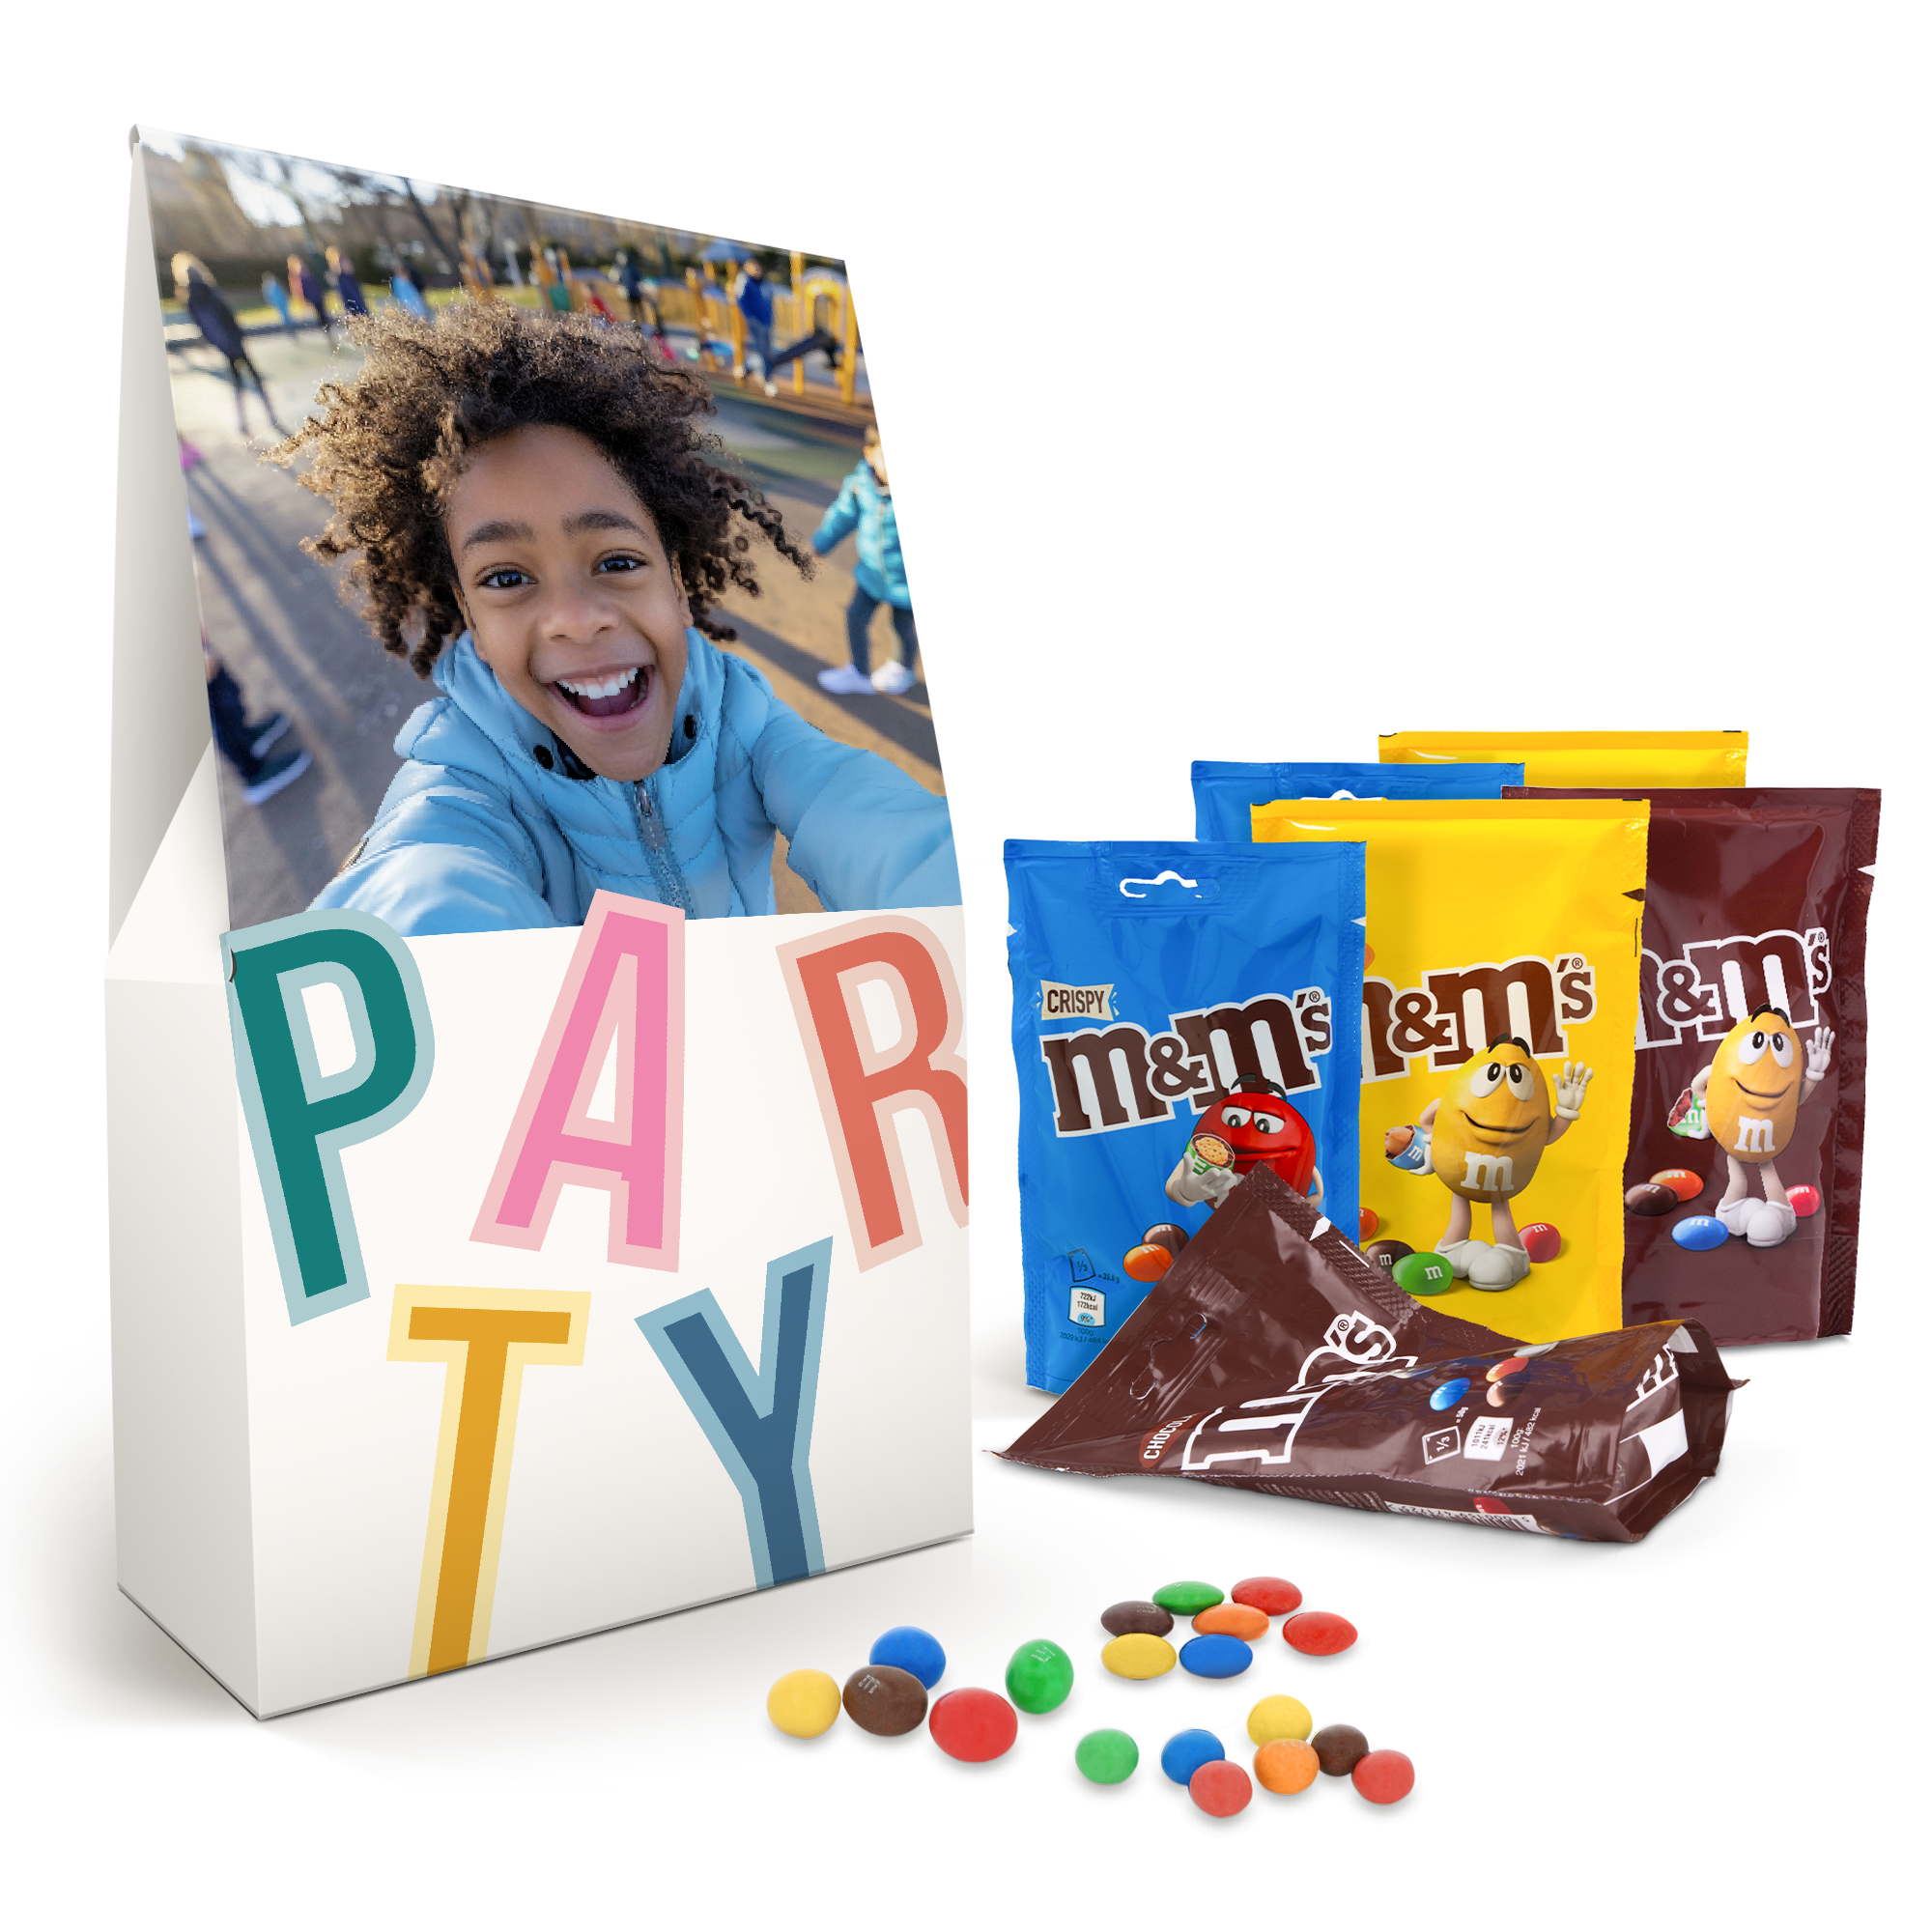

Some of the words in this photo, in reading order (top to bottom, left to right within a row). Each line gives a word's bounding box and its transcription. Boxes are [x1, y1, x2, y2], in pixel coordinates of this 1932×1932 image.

[1047, 989, 1105, 1014] CRISPY
[1734, 1115, 1776, 1153] m
[1407, 1145, 1424, 1162] m
[1460, 1151, 1516, 1192] m
[1666, 1170, 1687, 1179] m
[1640, 1182, 1662, 1194] m
[1532, 1224, 1548, 1234] m
[1689, 1217, 1710, 1227] m
[1140, 1243, 1160, 1255] m
[1378, 1253, 1393, 1266] m
[1424, 1264, 1444, 1281] m
[1080, 1292, 1096, 1302] 722kJ
[1077, 1300, 1098, 1311] 172kcal
[1433, 1387, 1447, 1399] m
[1456, 1406, 1468, 1418] 50g
[1529, 1407, 1542, 1422] kcal
[1524, 1422, 1535, 1436] 482
[1436, 1435, 1451, 1452] 1/3
[1471, 1425, 1486, 1448] 1011kJ
[1480, 1425, 1496, 1450] 241kcal
[1510, 1427, 1524, 1448] 100g:
[1520, 1442, 1529, 1453] kJ
[1516, 1455, 1526, 1476] 2021
